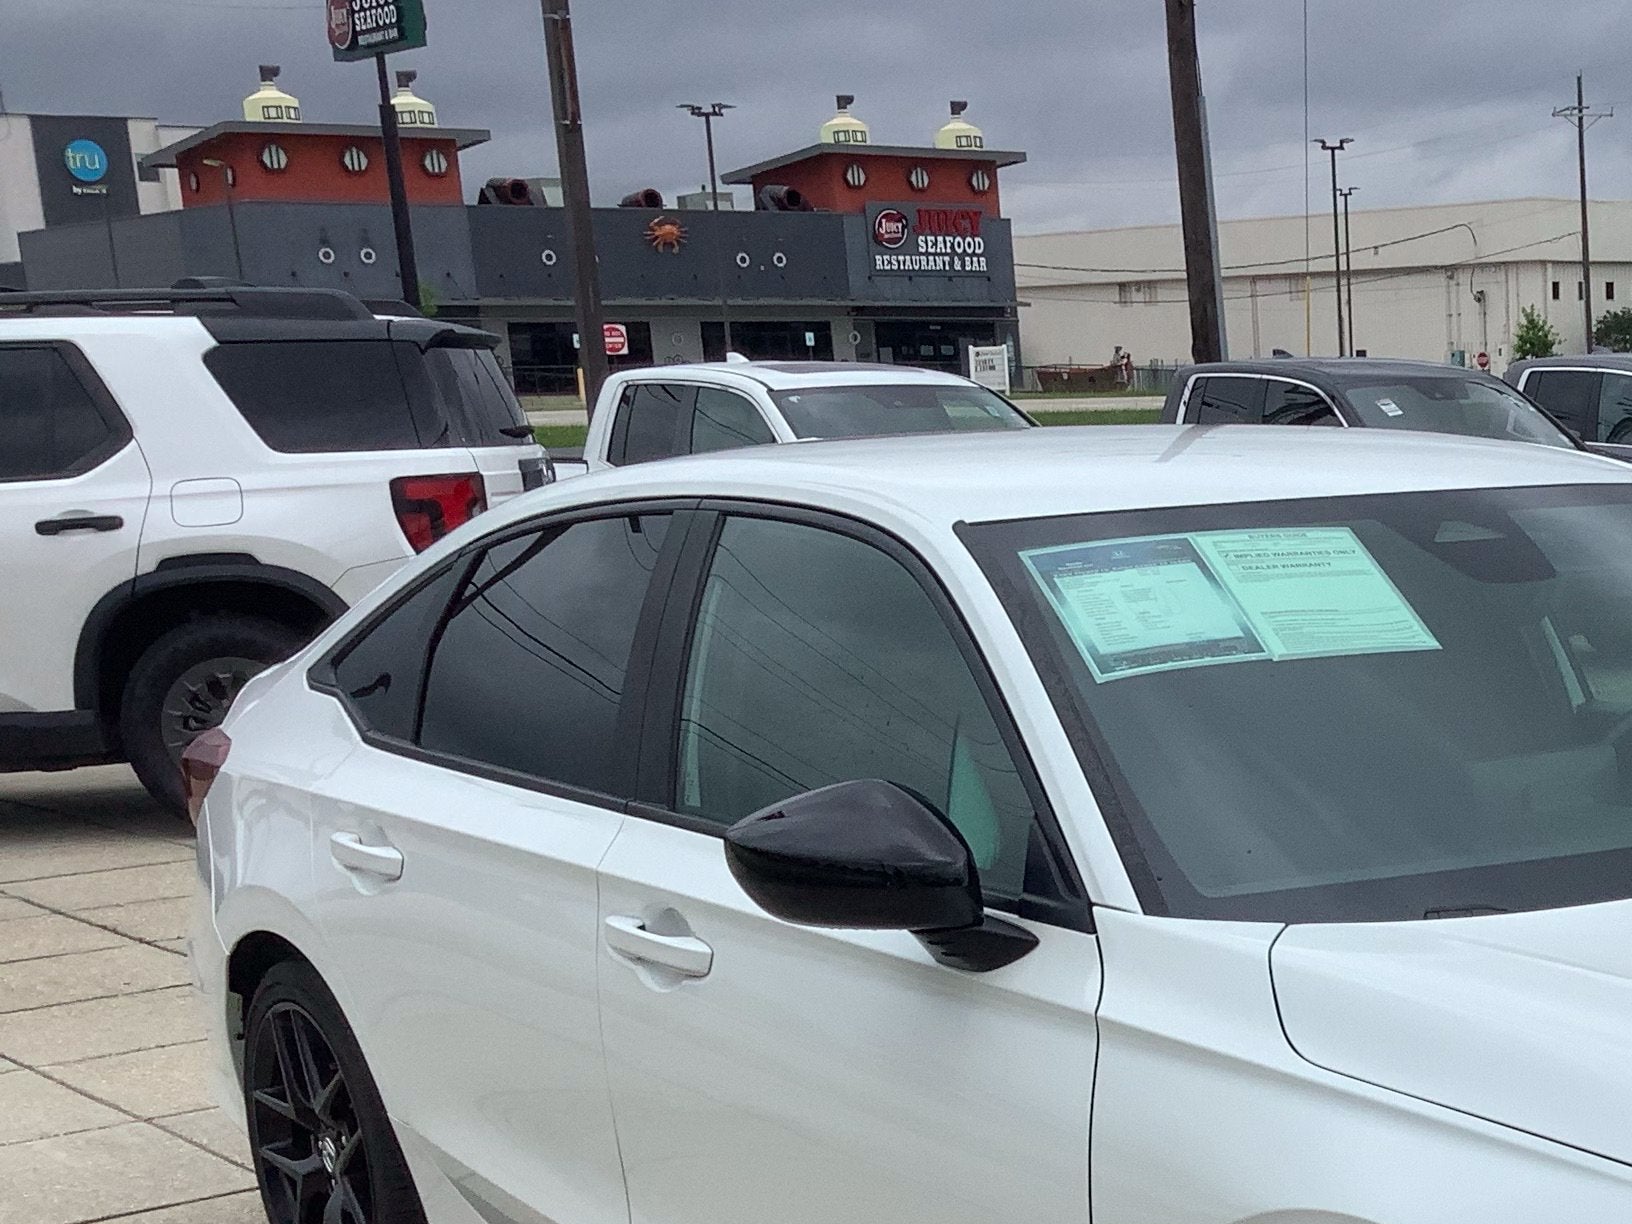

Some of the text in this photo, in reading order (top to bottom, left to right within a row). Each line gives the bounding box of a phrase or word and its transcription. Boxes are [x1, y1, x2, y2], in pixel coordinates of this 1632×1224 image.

[354, 5, 397, 31] SEAFOOD
[65, 148, 100, 169] tru
[912, 208, 982, 235] JUICY
[918, 235, 984, 254] SEAFOOD
[875, 255, 987, 271] RESTAURANT & BAR
